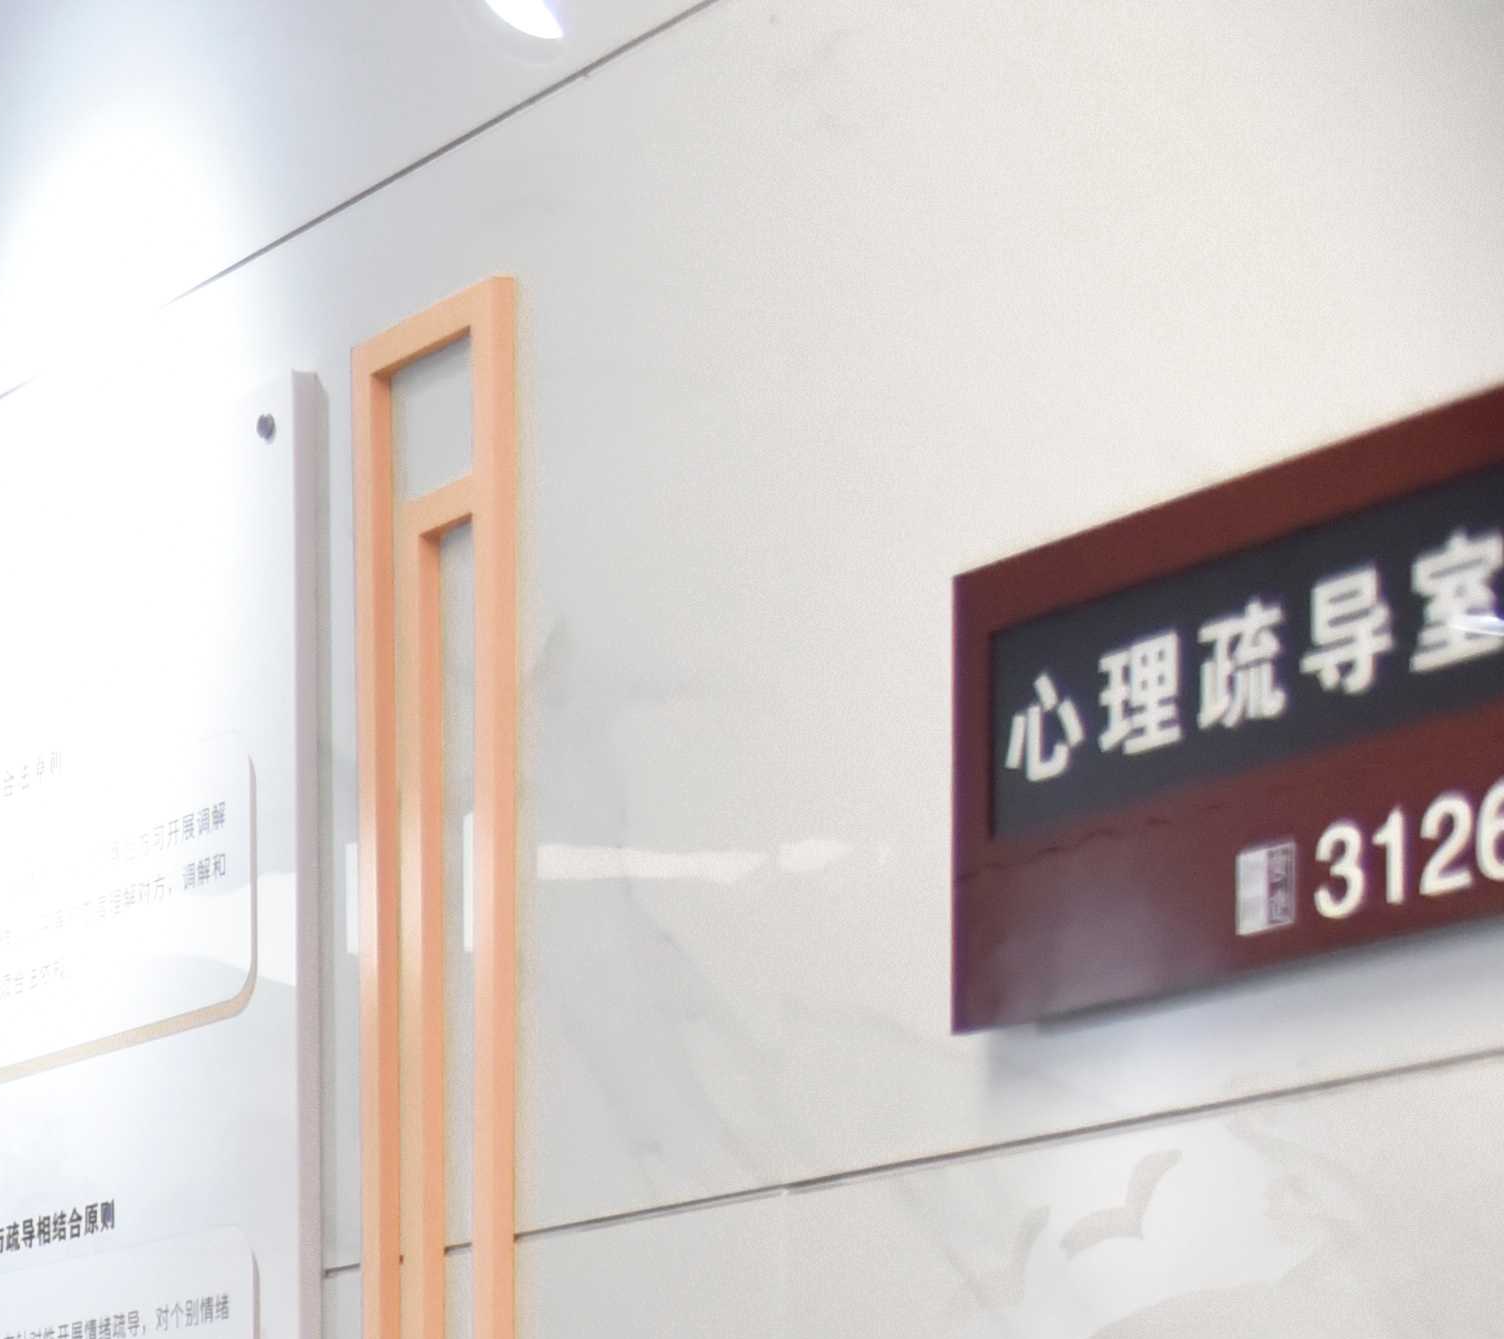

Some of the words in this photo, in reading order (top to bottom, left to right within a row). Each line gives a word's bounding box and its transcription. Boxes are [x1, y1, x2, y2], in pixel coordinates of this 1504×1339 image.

[1005, 528, 1504, 782] 心理疏导室
